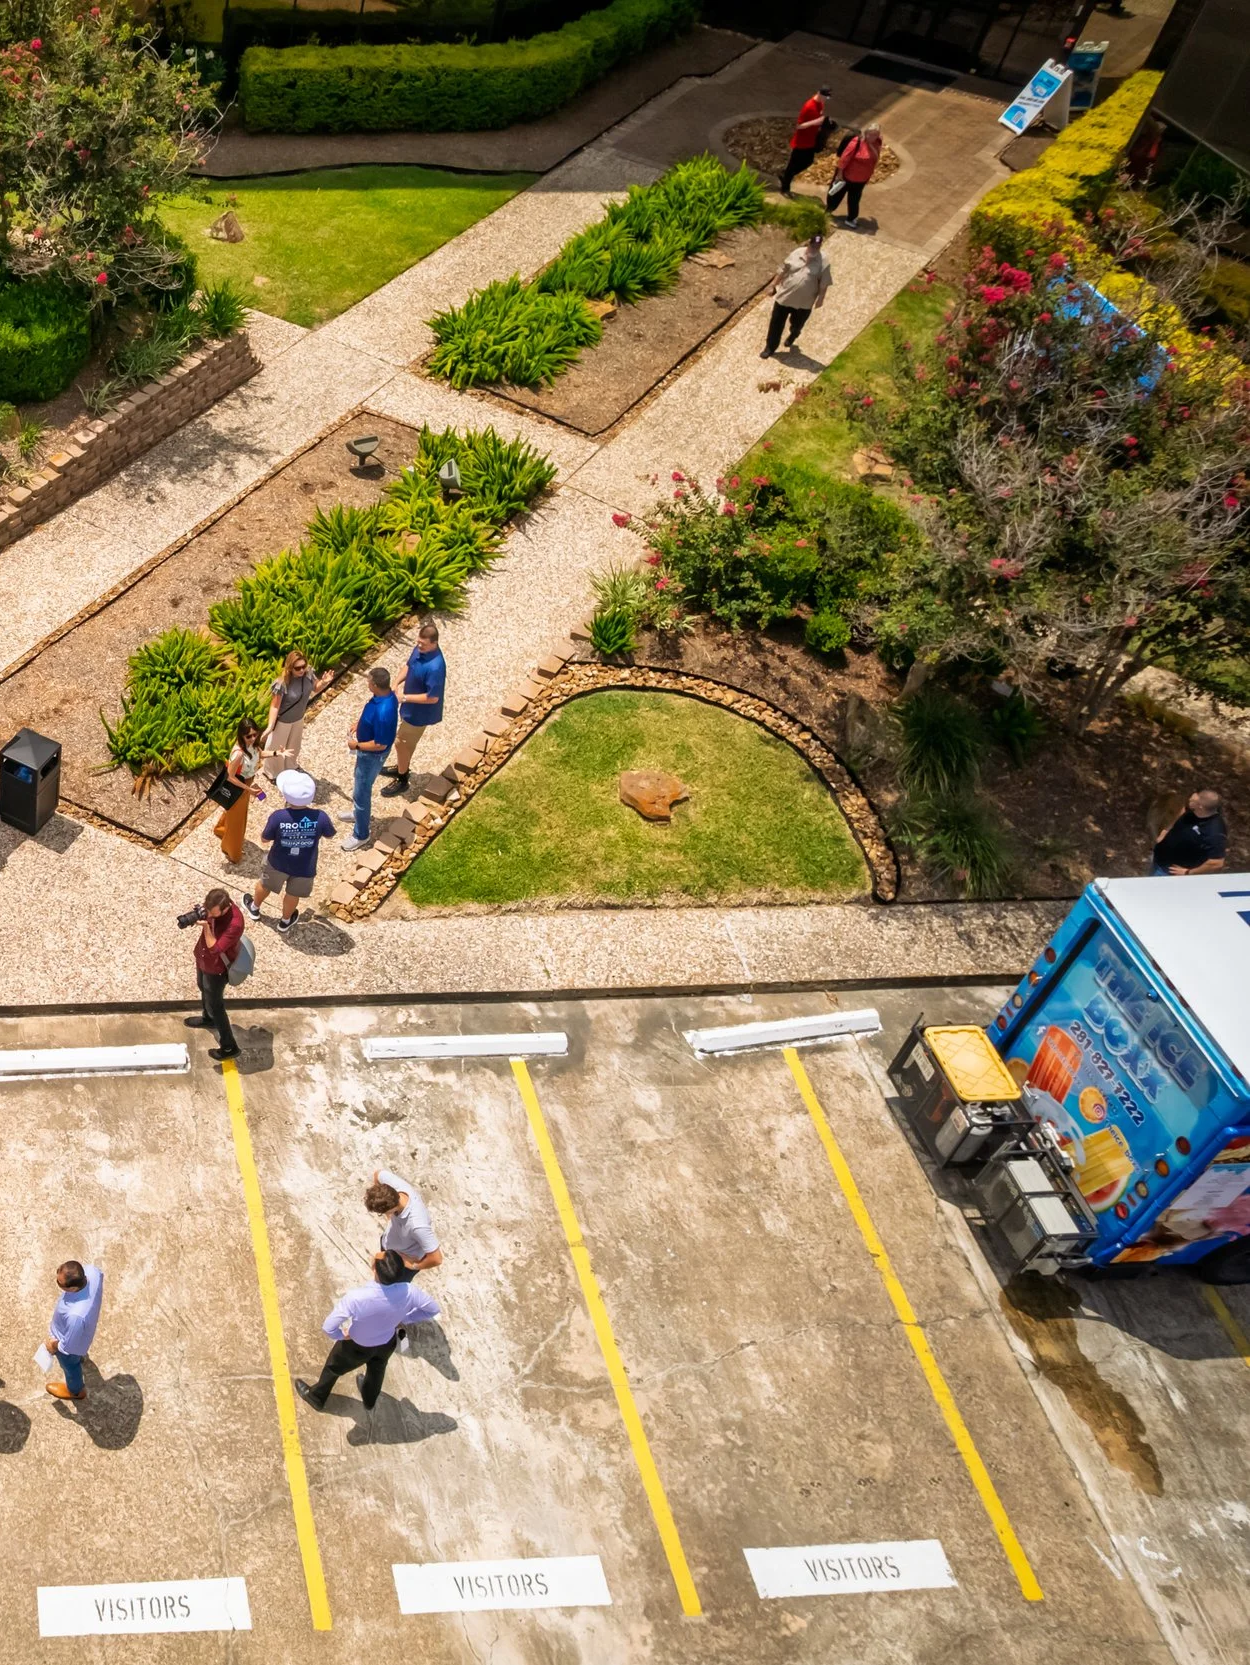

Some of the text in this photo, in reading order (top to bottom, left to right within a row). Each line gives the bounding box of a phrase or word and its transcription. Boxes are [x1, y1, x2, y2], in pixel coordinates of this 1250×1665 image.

[804, 1556, 901, 1582] VISITORS
[453, 1573, 549, 1599] VISITORS
[94, 1595, 191, 1622] VISITORS
